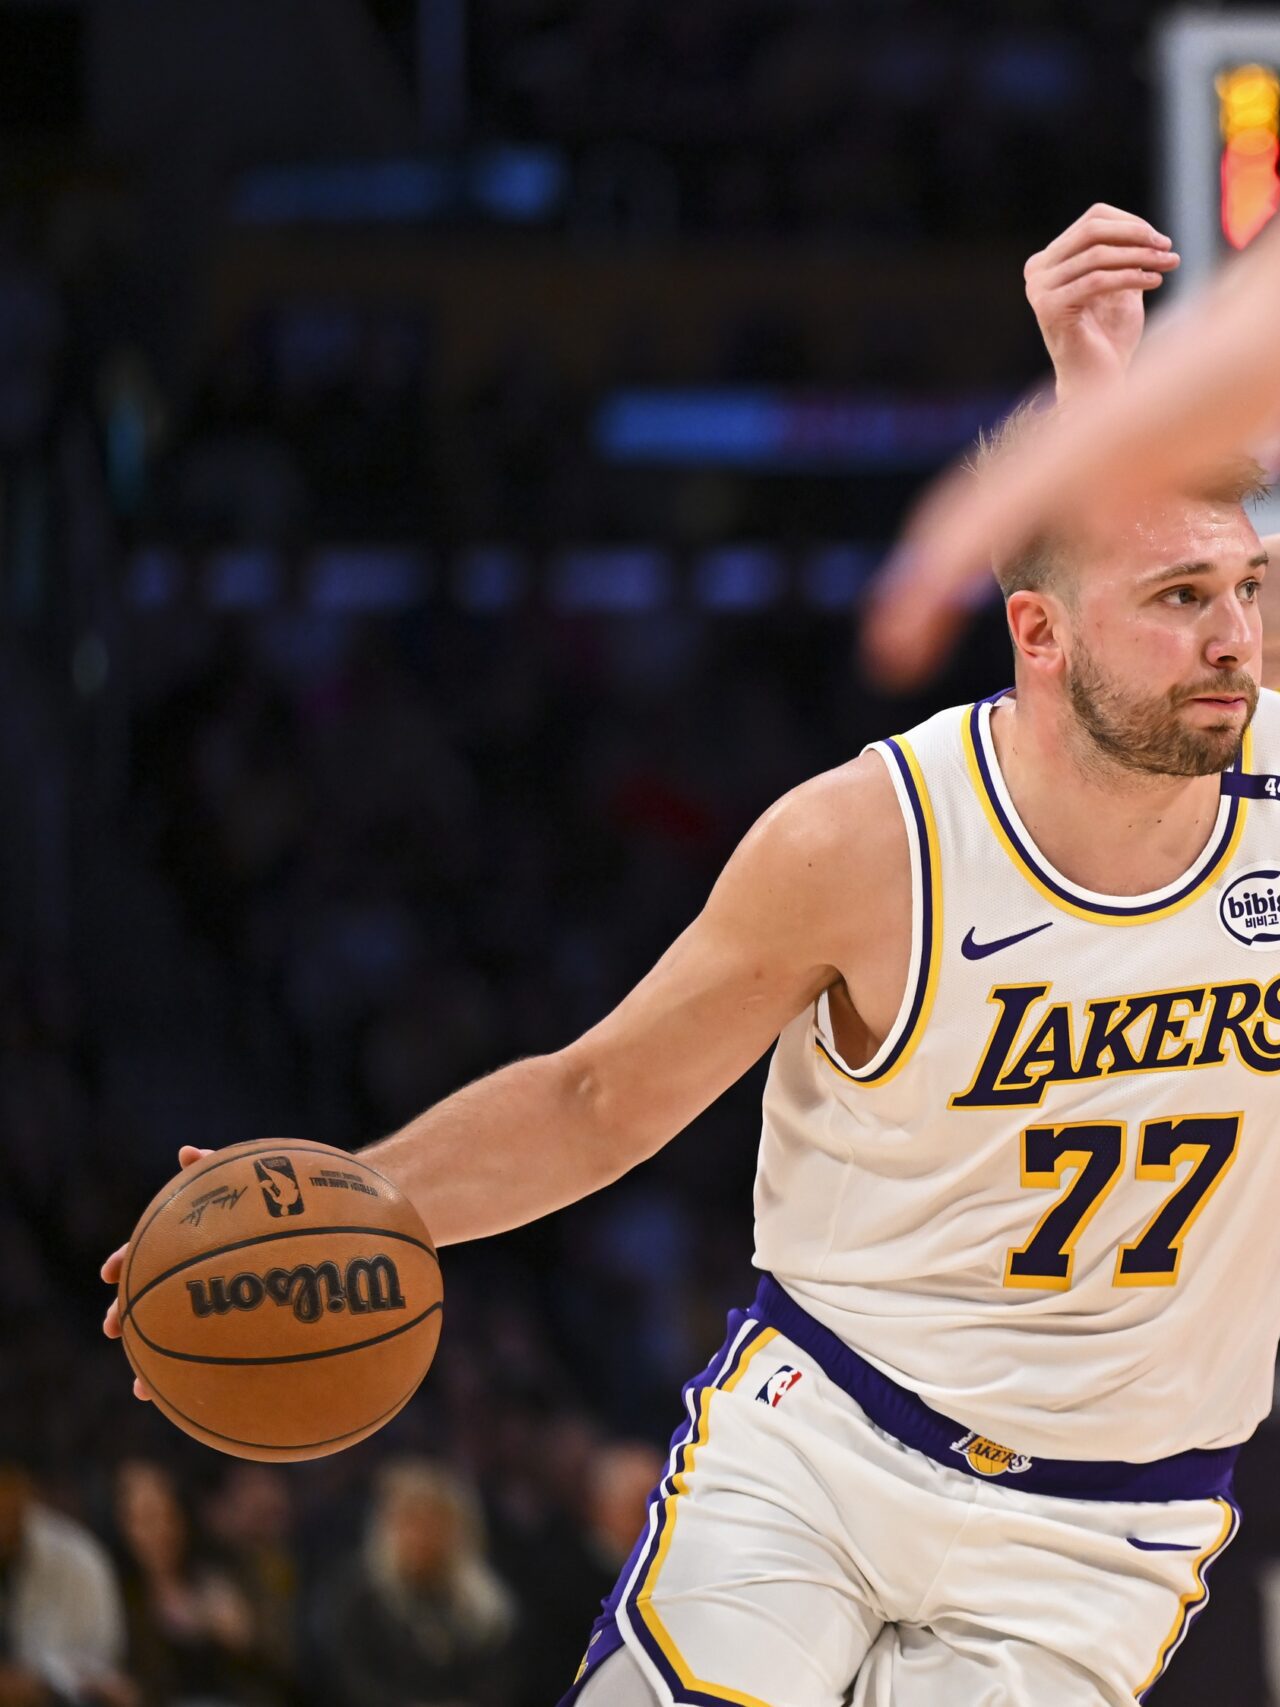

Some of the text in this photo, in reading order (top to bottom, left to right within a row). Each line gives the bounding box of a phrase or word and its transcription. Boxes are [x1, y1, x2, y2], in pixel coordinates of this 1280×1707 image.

[1245, 914, 1279, 928] 비비고
[1003, 1111, 1245, 1291] 77
[186, 1253, 406, 1324] Wilson
[957, 1434, 1032, 1470] LAKERS
